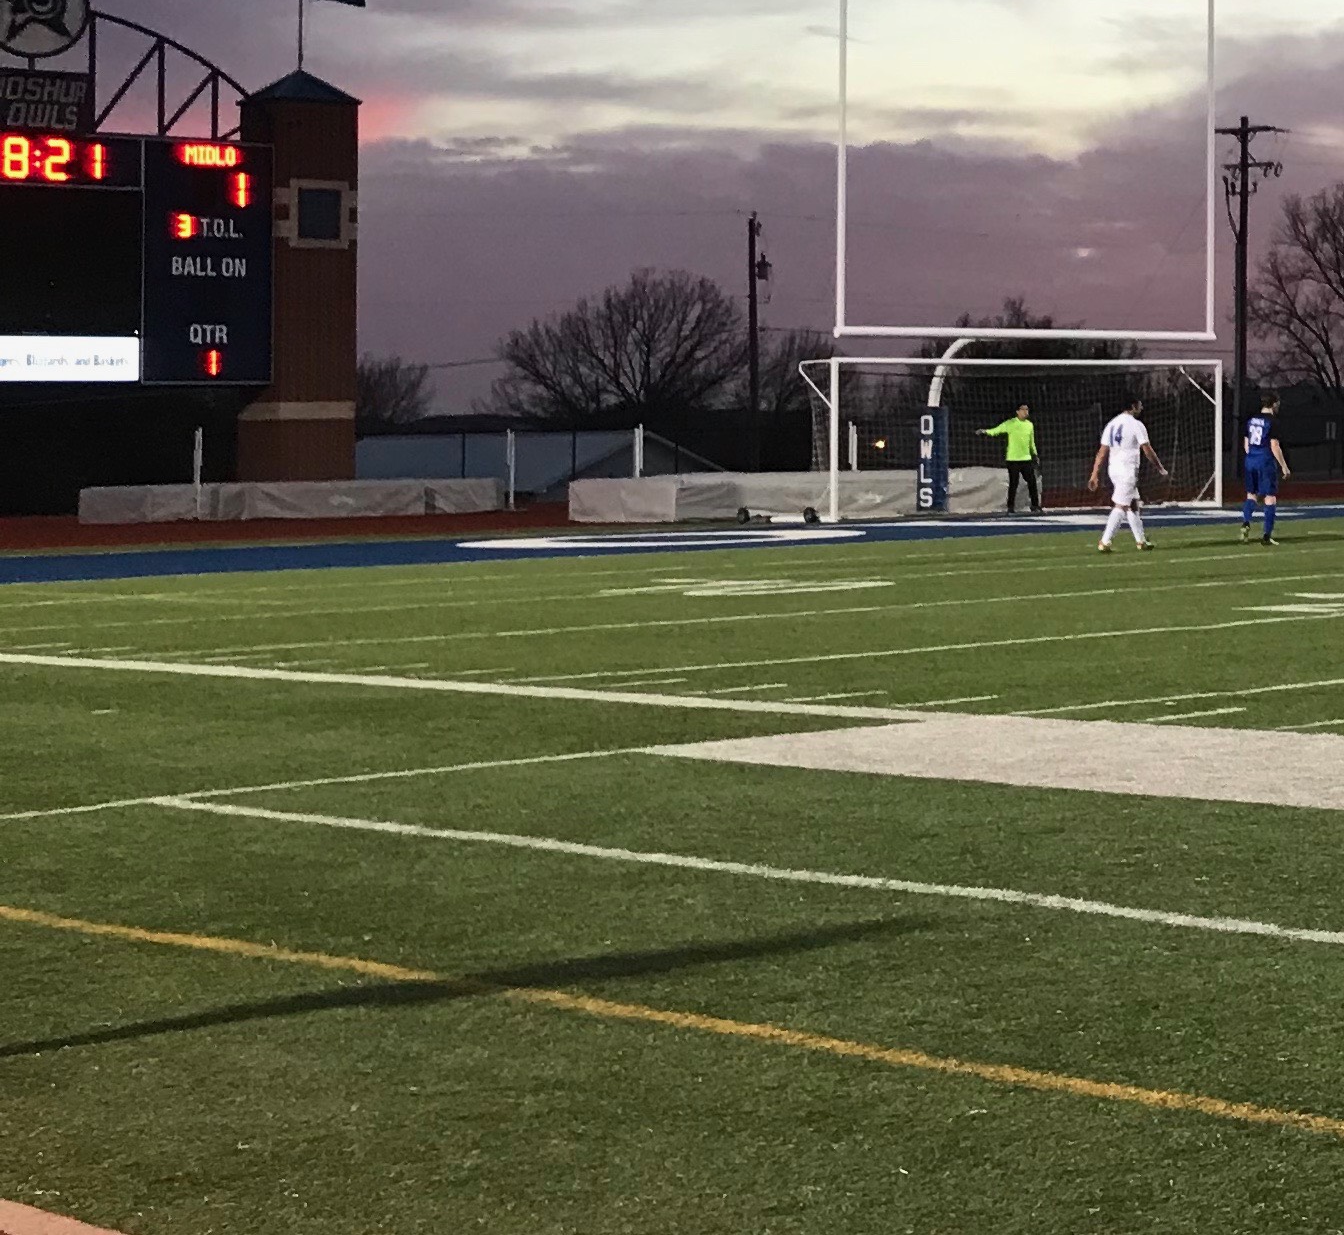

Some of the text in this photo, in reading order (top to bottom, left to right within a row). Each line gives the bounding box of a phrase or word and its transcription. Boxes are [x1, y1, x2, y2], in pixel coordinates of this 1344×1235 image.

[7, 102, 78, 130] OWLS
[184, 144, 237, 167] MIDLO
[237, 171, 248, 208] 1
[176, 213, 193, 239] 3
[171, 256, 247, 278] BALL ON
[189, 323, 228, 344] QTR
[1109, 423, 1123, 448] 14
[919, 414, 934, 508] OWLS
